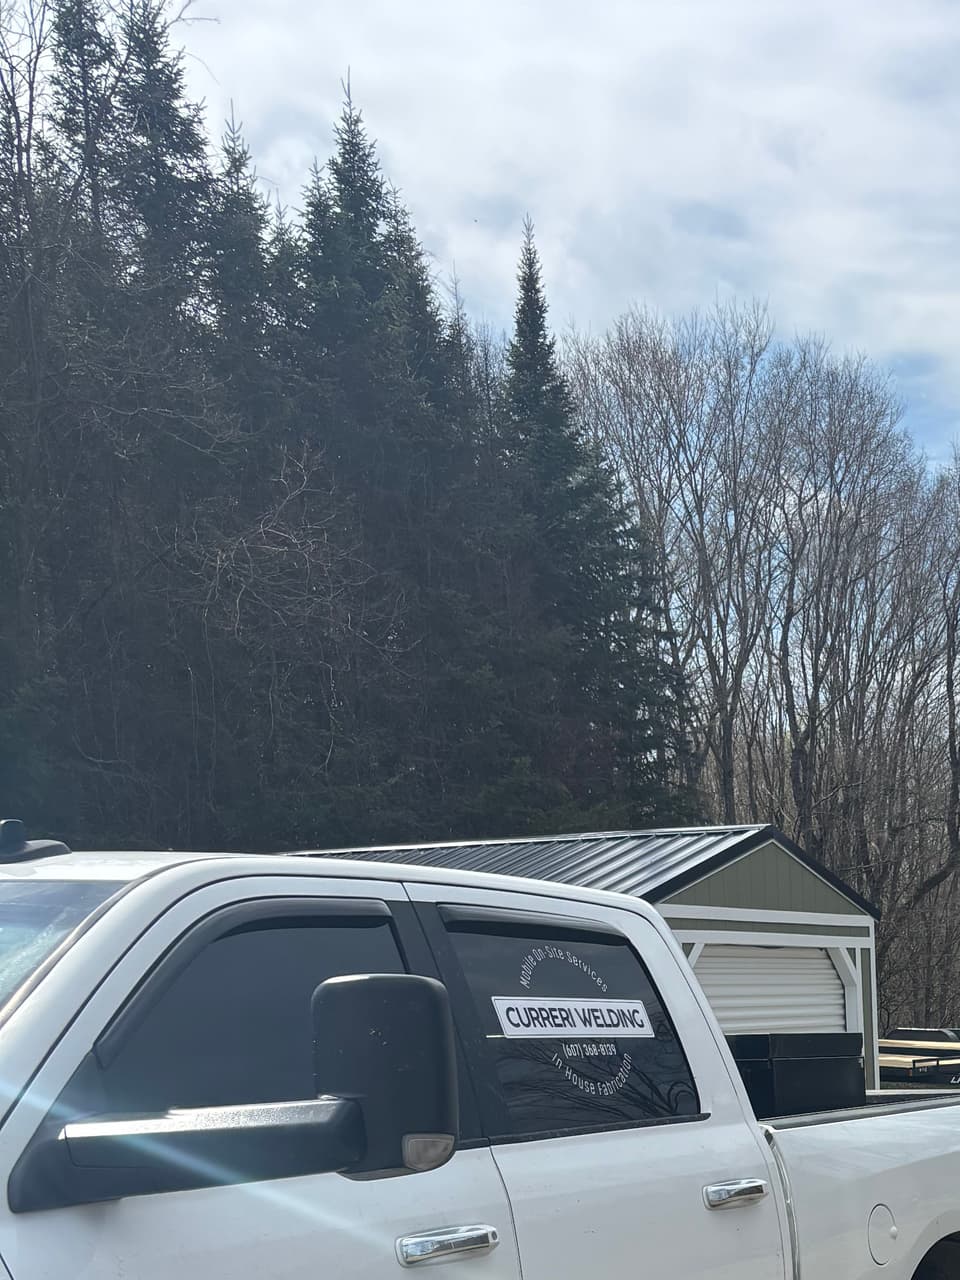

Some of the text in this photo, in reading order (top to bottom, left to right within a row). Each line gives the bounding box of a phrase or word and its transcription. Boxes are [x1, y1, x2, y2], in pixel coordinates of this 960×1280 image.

[520, 945, 608, 992] Mobile On-Site Services
[506, 1006, 645, 1029] CURRERI WELDING
[562, 1043, 584, 1059] (607)
[552, 1053, 632, 1096] In House Fabrication
